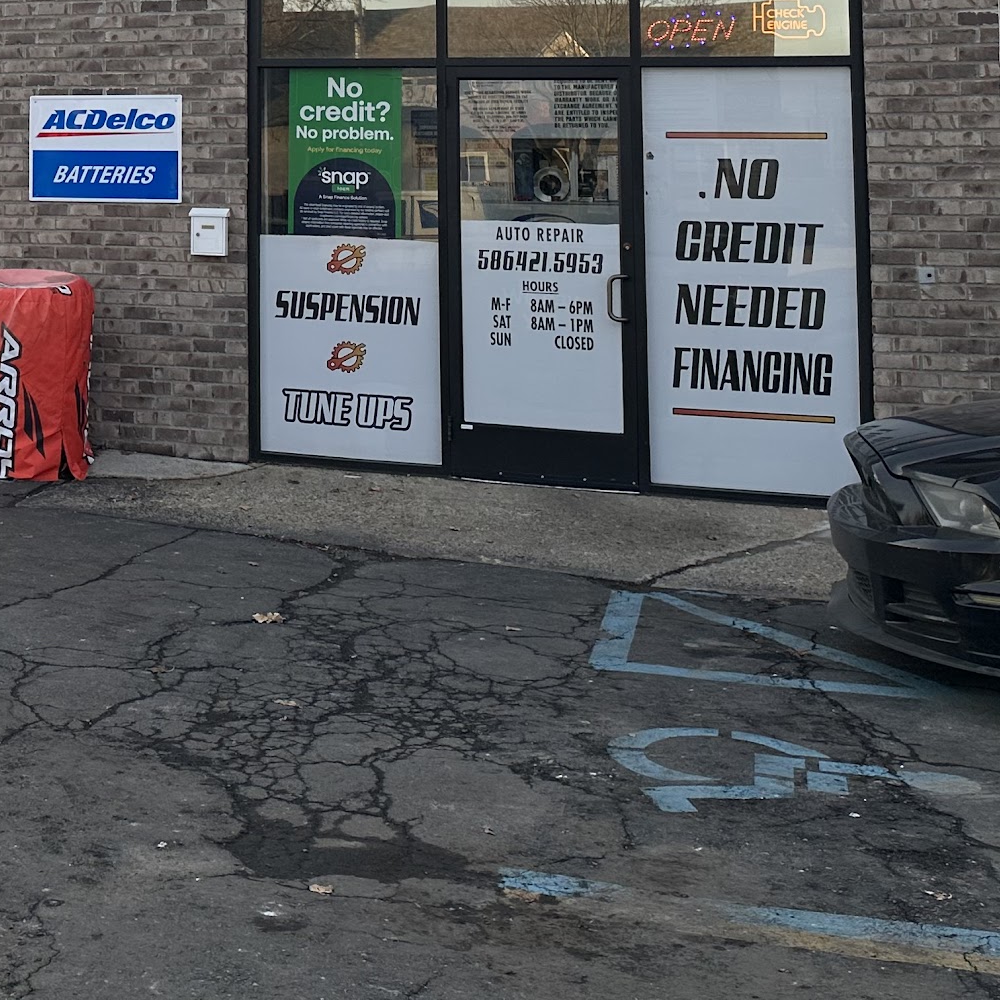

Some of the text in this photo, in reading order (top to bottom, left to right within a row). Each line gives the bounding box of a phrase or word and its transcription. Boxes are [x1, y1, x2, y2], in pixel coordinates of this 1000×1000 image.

[766, 8, 805, 19] CHECK
[647, 19, 736, 41] OPEN
[767, 19, 807, 30] ENGINE
[327, 77, 363, 98] No
[42, 108, 176, 130] ACDelco
[299, 100, 391, 122] credit?
[296, 126, 394, 142] No problem.
[336, 146, 364, 154] financing
[53, 165, 156, 184] BATTERIES
[321, 171, 369, 190] snap
[496, 226, 584, 243] AUTO REPAIR
[675, 221, 824, 265] CREDIT
[478, 249, 604, 274] 586.421.5953
[522, 281, 559, 292] HOURS
[275, 290, 421, 326] SUSPENSION
[491, 297, 511, 312] M-F
[530, 299, 555, 313] 8AM
[569, 301, 593, 315] 6PM
[675, 283, 826, 330] NEEDED
[493, 315, 511, 329] SAT
[531, 317, 555, 331] 8AM
[570, 318, 594, 333] 1PM
[490, 332, 594, 351] SUN CLOSED
[672, 347, 833, 396] FINANCING
[282, 388, 413, 431] TUNE UPS
